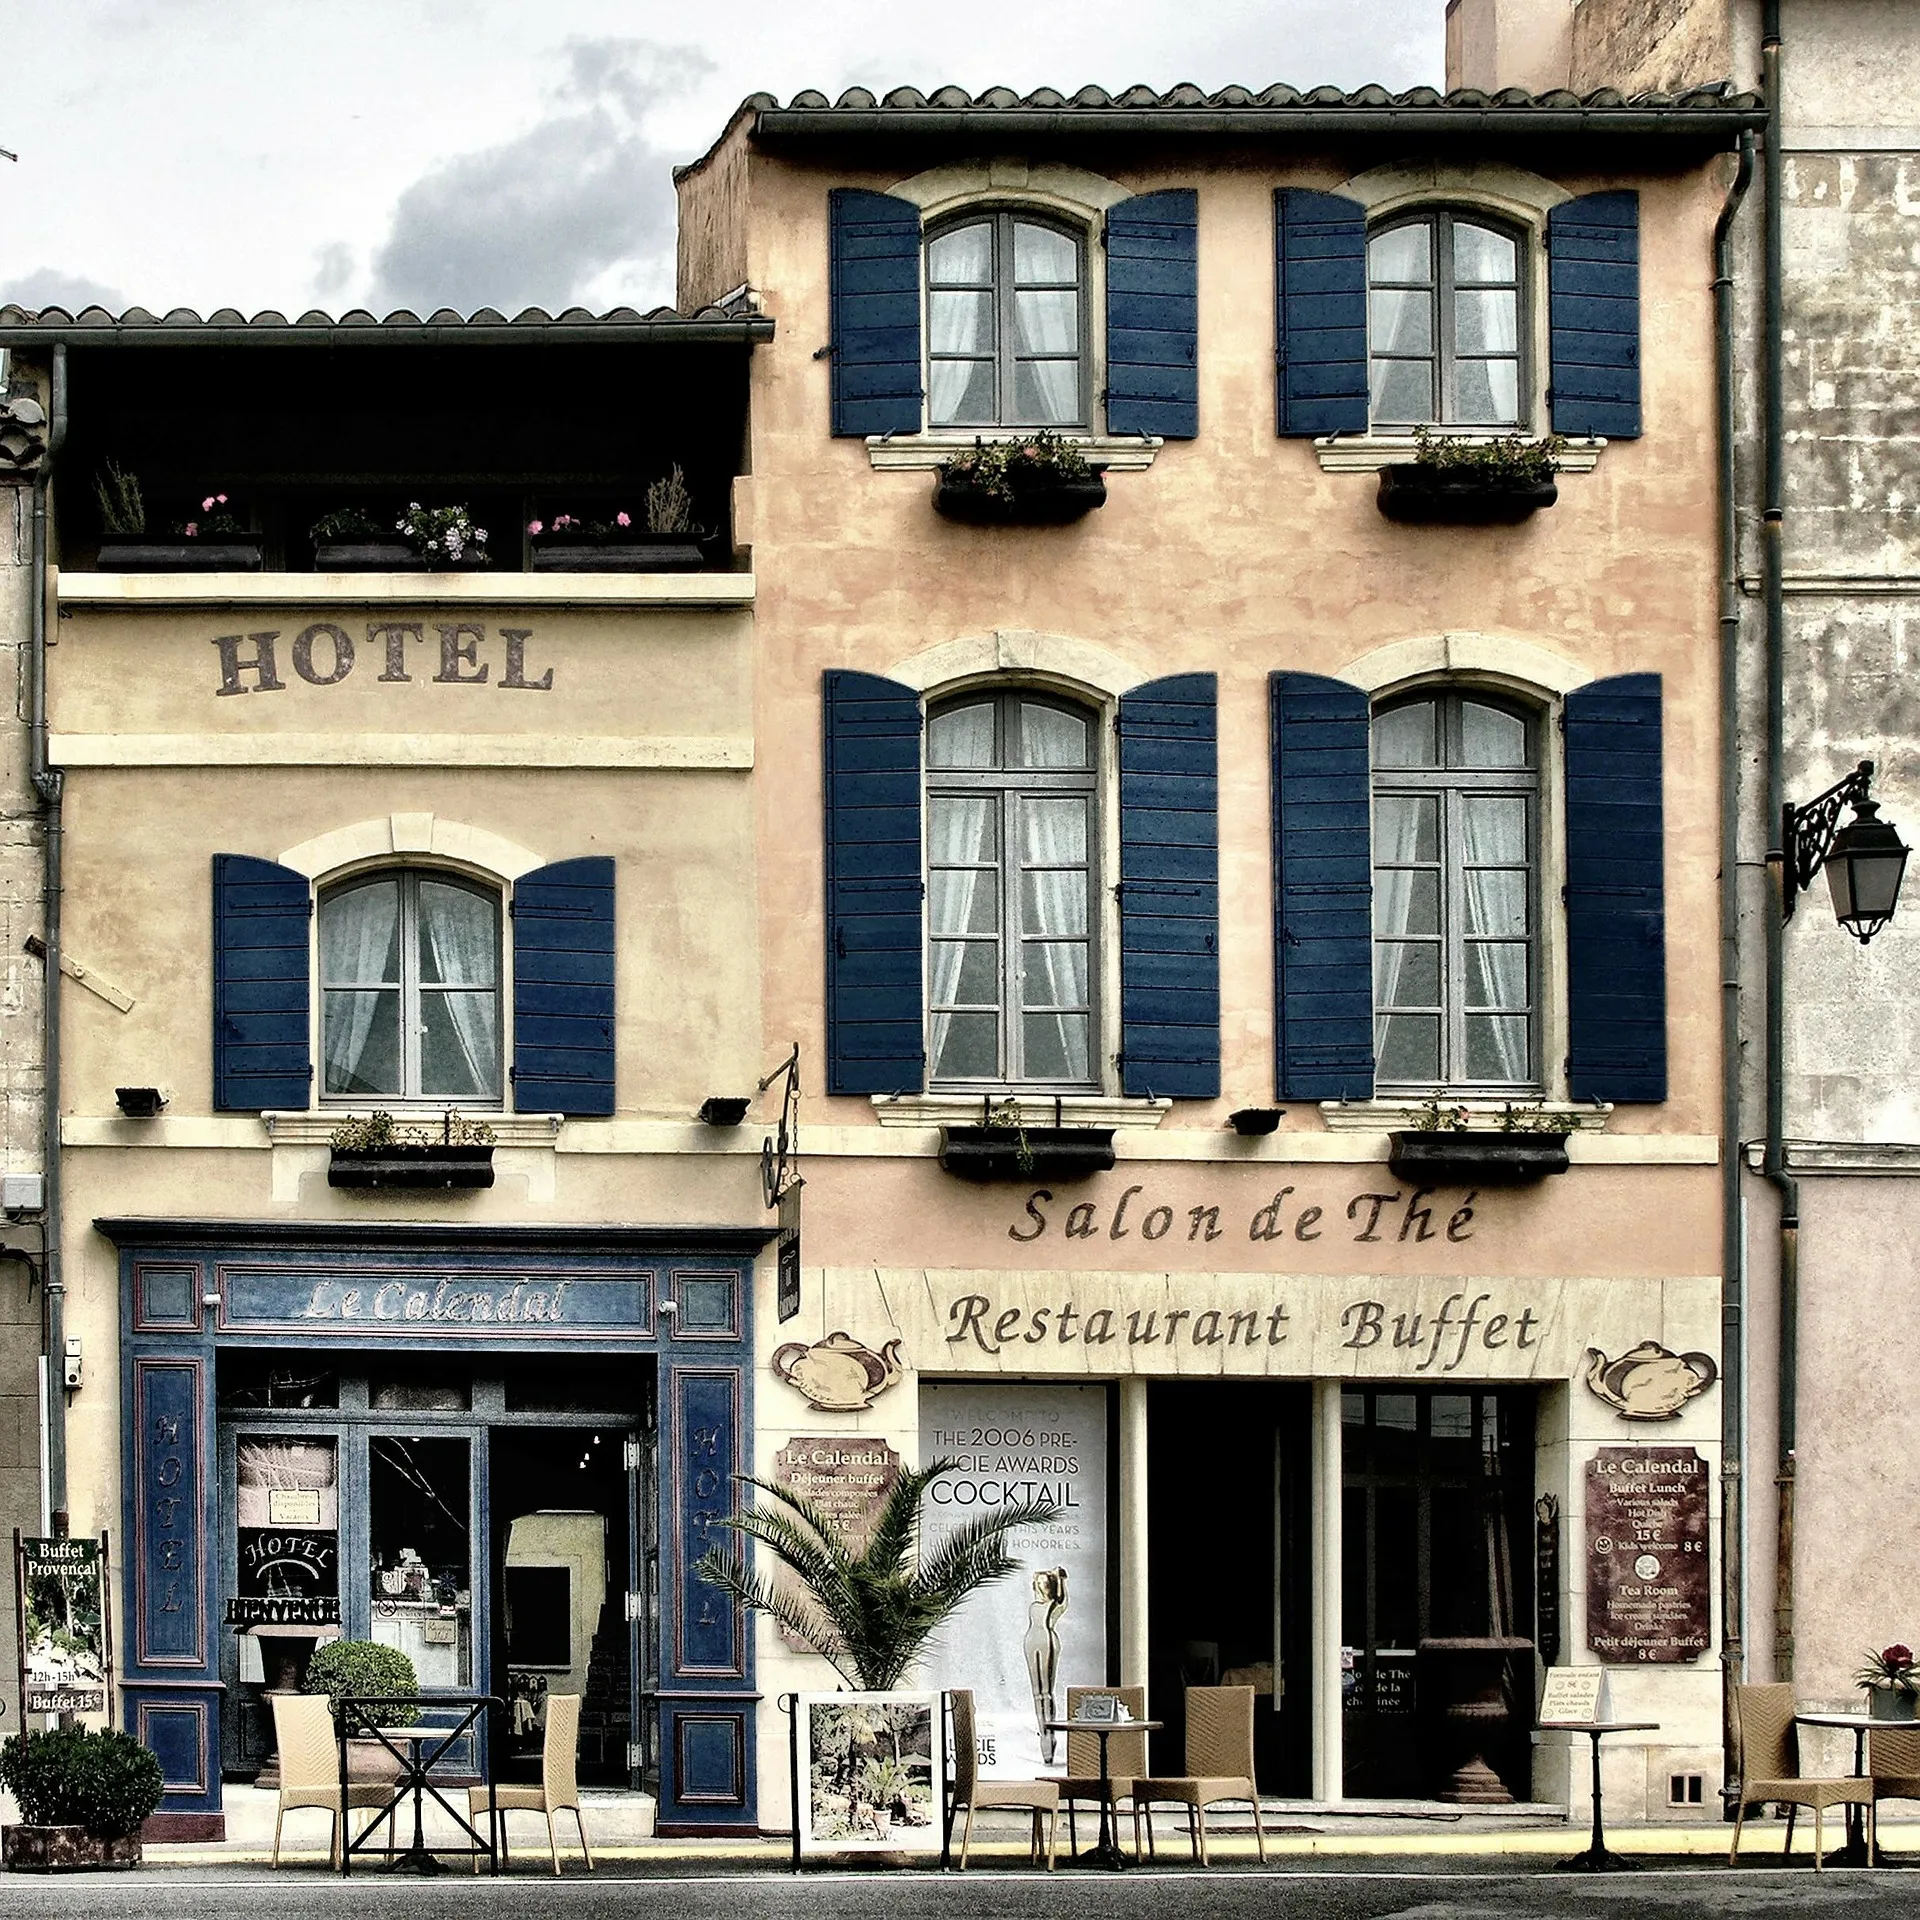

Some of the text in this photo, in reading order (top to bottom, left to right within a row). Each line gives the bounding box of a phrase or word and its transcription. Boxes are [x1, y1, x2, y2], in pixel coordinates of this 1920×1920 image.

[211, 623, 554, 696] HOTEL
[1008, 1185, 1477, 1243] Salon de Thé
[300, 1277, 573, 1321] Le Calendal
[946, 1293, 1540, 1372] Restaurant Buffet
[932, 1428, 1078, 1448] THE 2006 PRE-
[786, 1449, 889, 1466] Le Calendal
[994, 1455, 1080, 1474] AWARDS
[1596, 1458, 1699, 1474] Le Calendal
[848, 1473, 885, 1485] buffet
[931, 1479, 1080, 1507] COCKTAIL
[1609, 1483, 1686, 1494] Buffet Lunch
[153, 1411, 185, 1613] HOTEL
[691, 1423, 722, 1626] HOTL
[1636, 1530, 1650, 1540] 15
[39, 1543, 84, 1558] Buffet
[245, 1533, 334, 1568] HOTEL
[1684, 1541, 1692, 1552] 8
[28, 1560, 97, 1578] Provençal
[1619, 1585, 1679, 1596] Tea Room
[1593, 1637, 1619, 1647] Petit
[1670, 1636, 1705, 1647] Buffet
[1638, 1649, 1647, 1660] 8
[32, 1695, 75, 1710] Buffet
[949, 1738, 996, 1752] LIE
